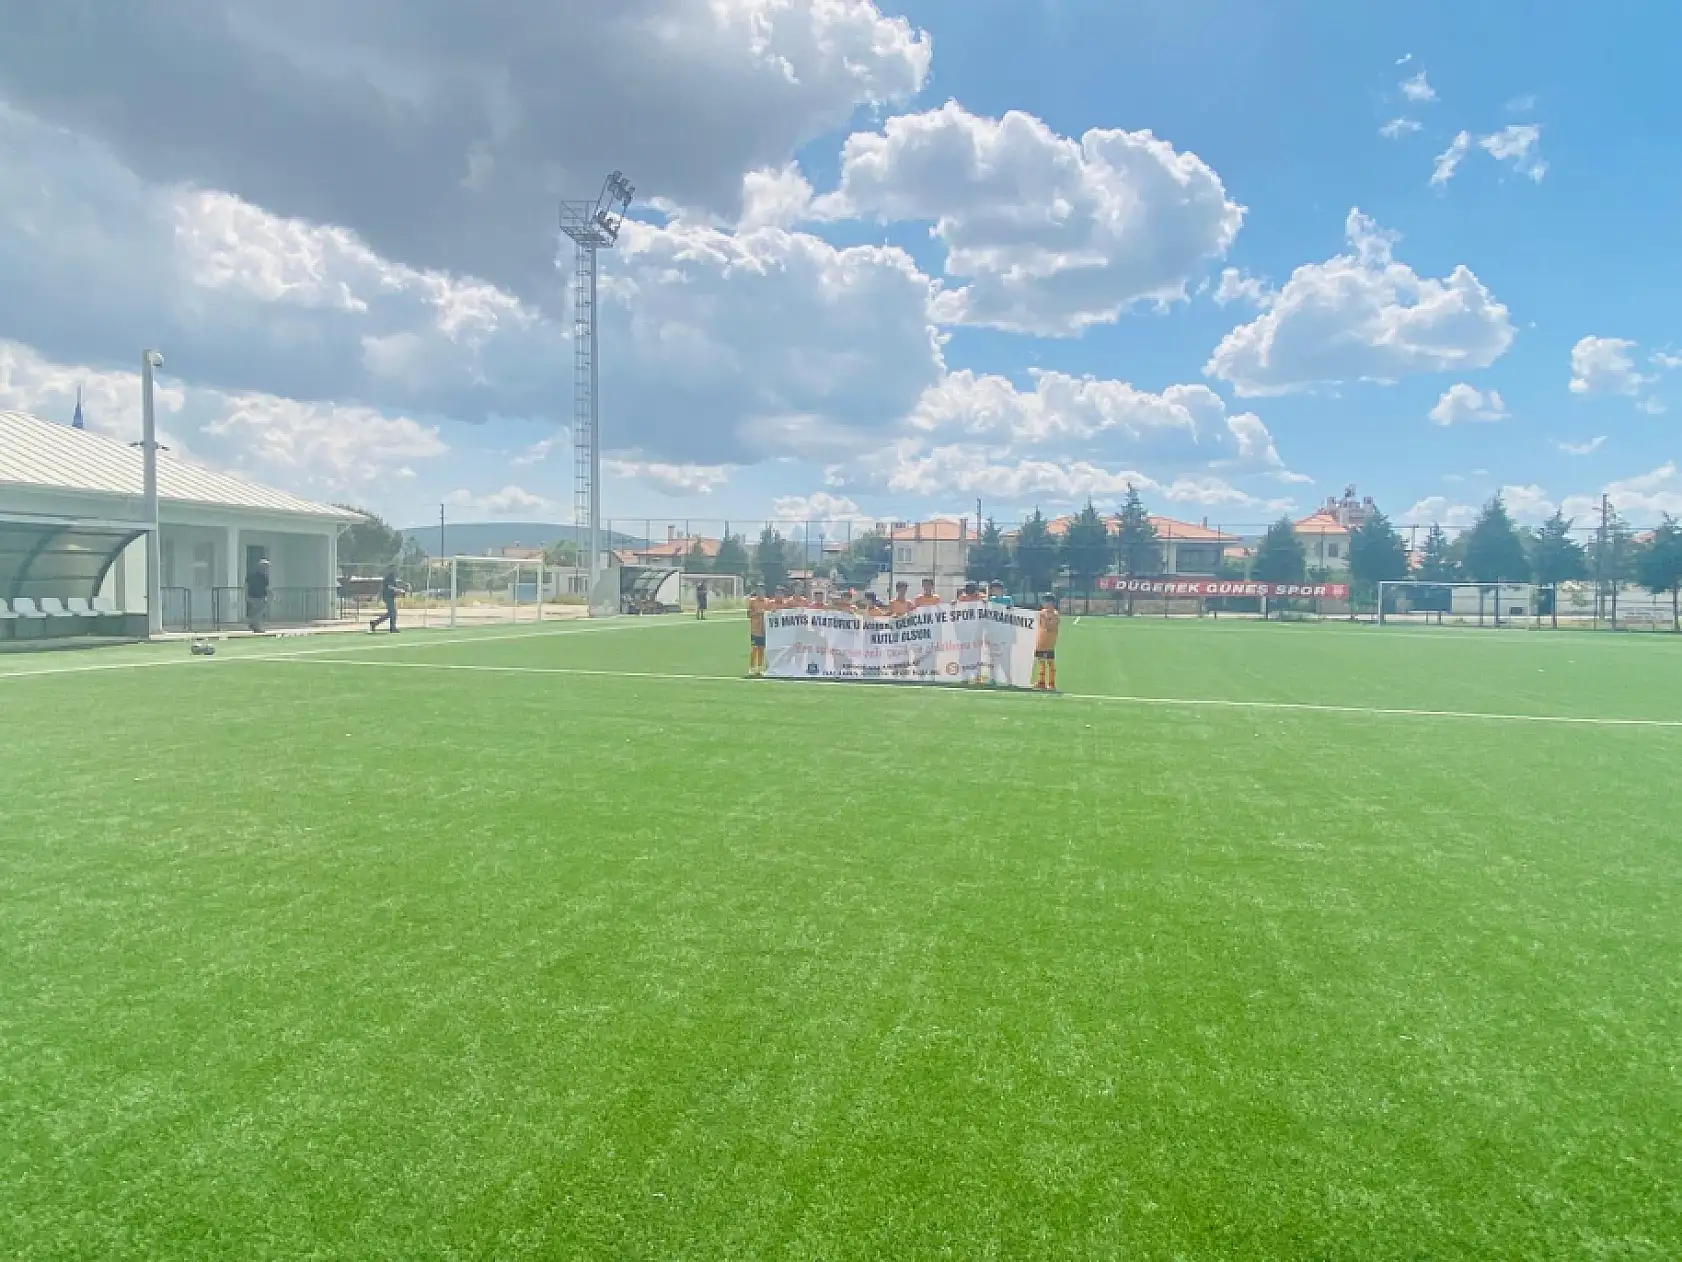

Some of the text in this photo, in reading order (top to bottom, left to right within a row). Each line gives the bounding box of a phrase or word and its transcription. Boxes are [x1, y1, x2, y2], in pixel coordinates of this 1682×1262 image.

[1275, 584, 1326, 595] SPOR
[782, 615, 809, 628] MAYIS
[935, 611, 949, 623] VE
[950, 609, 976, 622] SPOR
